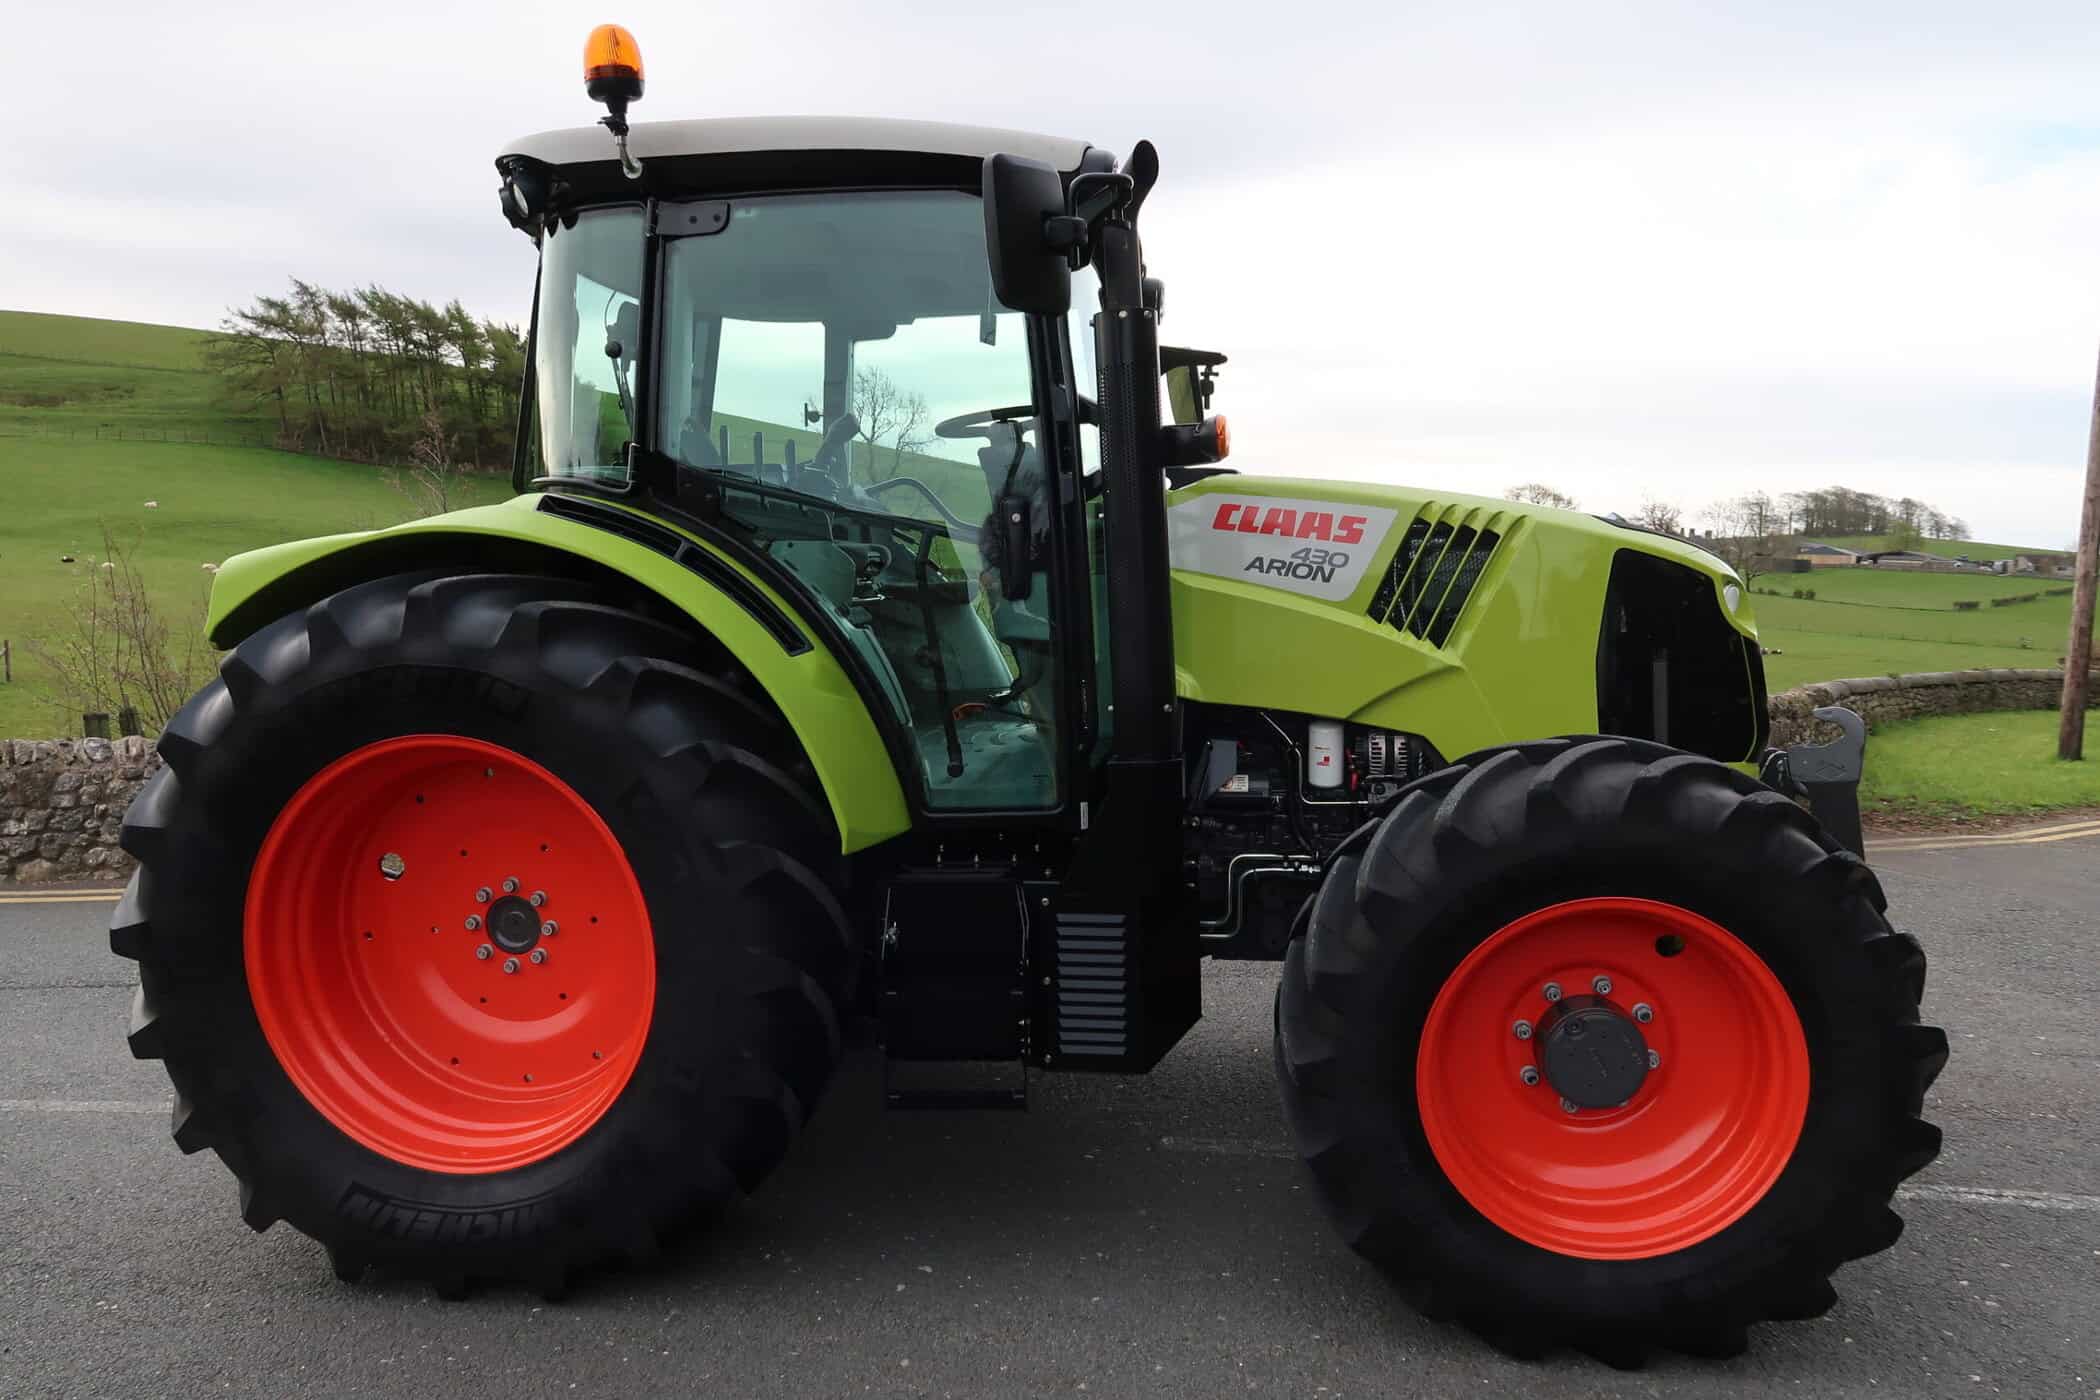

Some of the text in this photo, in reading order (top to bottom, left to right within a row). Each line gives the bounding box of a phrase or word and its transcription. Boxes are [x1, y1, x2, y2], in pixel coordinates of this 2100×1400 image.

[1212, 503, 1367, 544] CLAAS
[1244, 556, 1336, 583] ARION
[1291, 547, 1350, 568] 430
